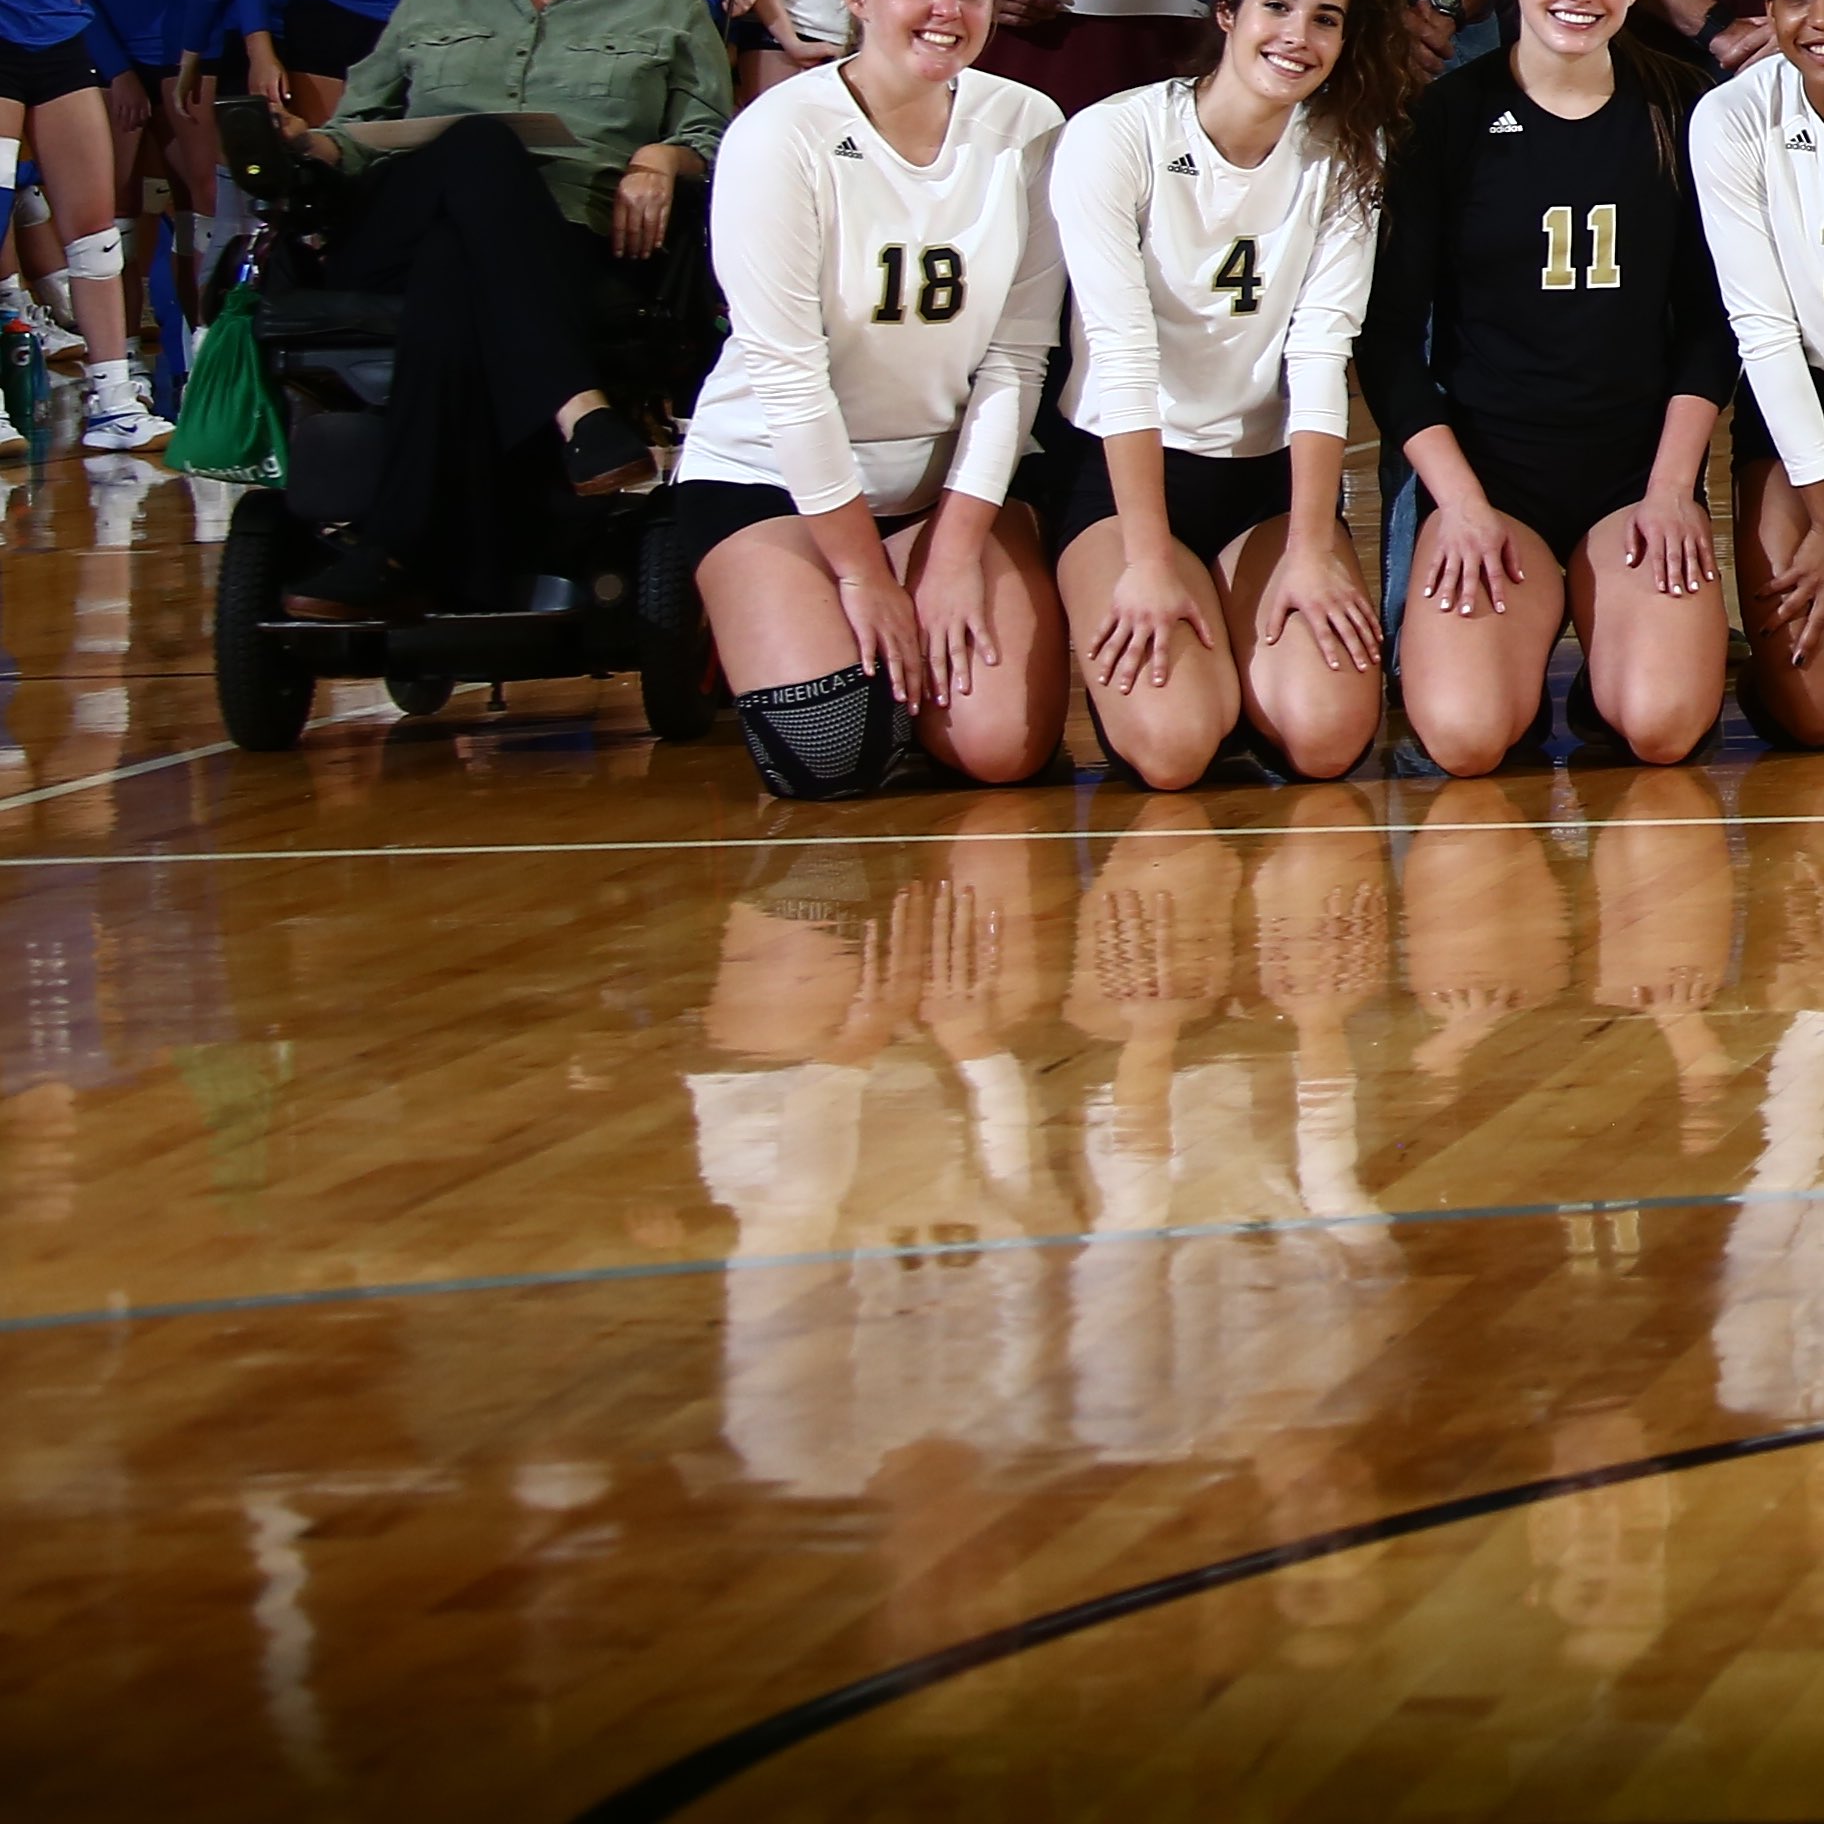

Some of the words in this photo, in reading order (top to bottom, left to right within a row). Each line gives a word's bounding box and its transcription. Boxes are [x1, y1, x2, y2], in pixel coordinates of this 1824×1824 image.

[1489, 124, 1523, 134] adidas
[871, 242, 968, 325] 18
[1212, 234, 1265, 317] 4
[1541, 204, 1621, 290] 11
[772, 674, 846, 704] NEENCA
